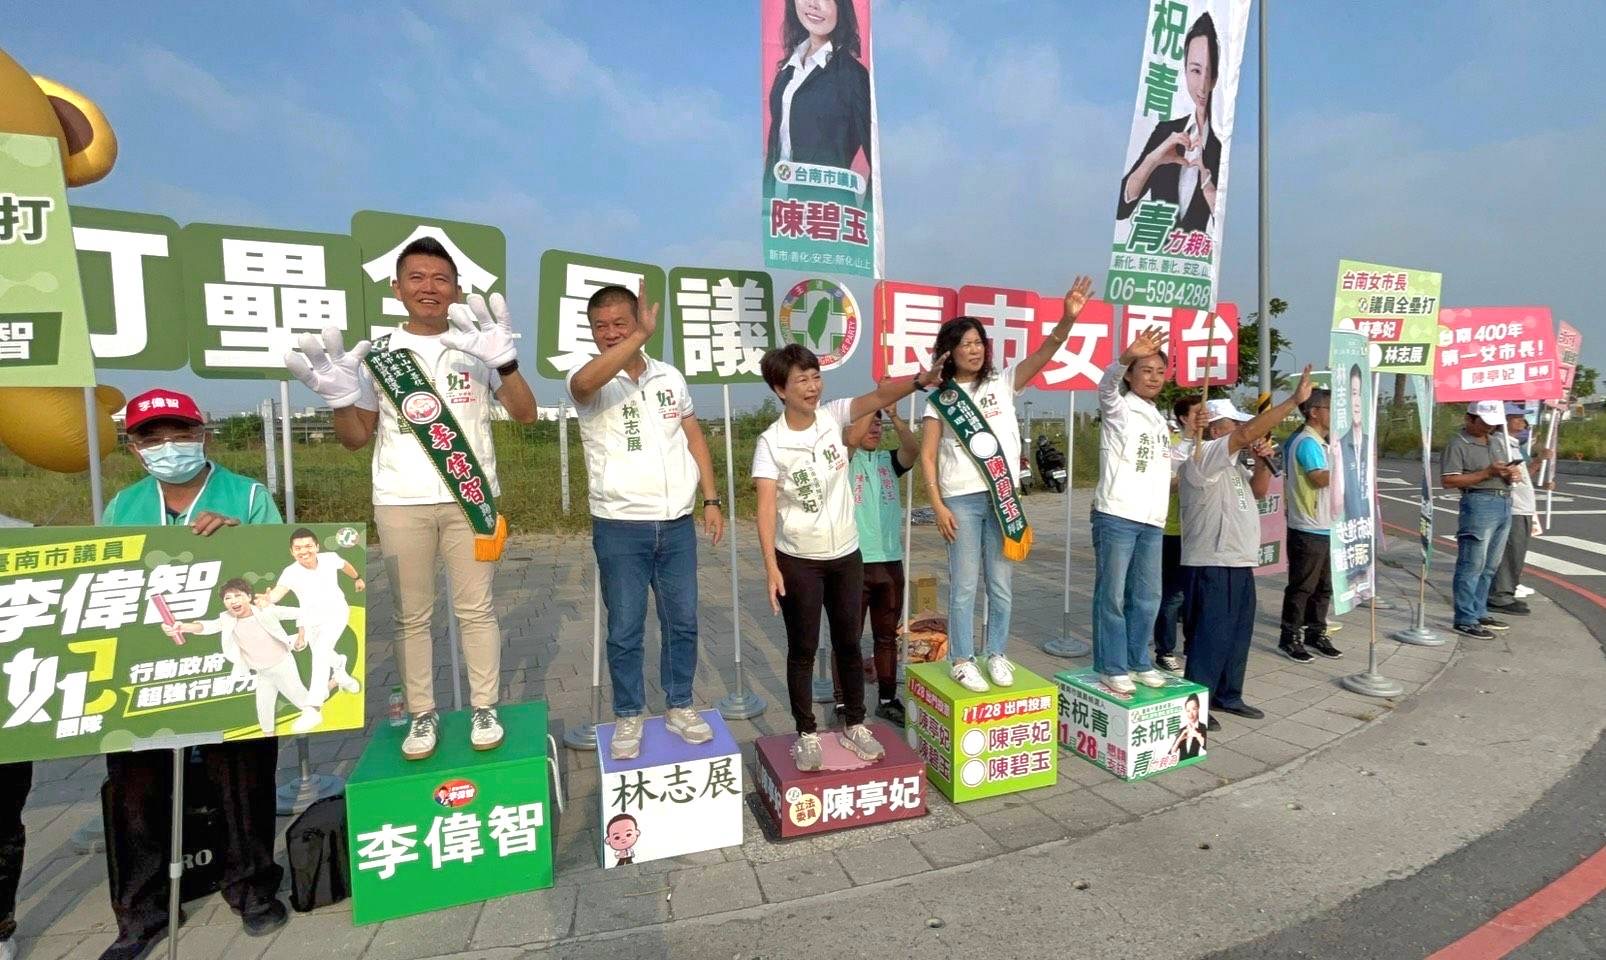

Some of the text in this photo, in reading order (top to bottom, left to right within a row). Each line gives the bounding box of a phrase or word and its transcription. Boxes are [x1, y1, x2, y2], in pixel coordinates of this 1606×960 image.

[794, 166, 859, 190] 台南市議員
[770, 199, 869, 247] 陳碧玉
[1342, 271, 1407, 291] 台南女市長
[1369, 296, 1436, 315] 議員全壘打
[1384, 346, 1424, 364] 林志展
[792, 468, 818, 514] 陳亭妃
[0, 560, 222, 644] 李偉智
[130, 652, 226, 684] 行動政府
[963, 695, 1052, 721] 11/28 出門投票
[1057, 692, 1109, 738] 余祝青
[988, 720, 1051, 752] 陳亭妃
[1131, 715, 1183, 748] 余祝青
[988, 750, 1051, 781] 陳碧玉
[611, 757, 743, 813] 林志展
[822, 776, 921, 824] 陳亭妃
[795, 798, 816, 812] 立法
[357, 802, 544, 880] 李偉智
